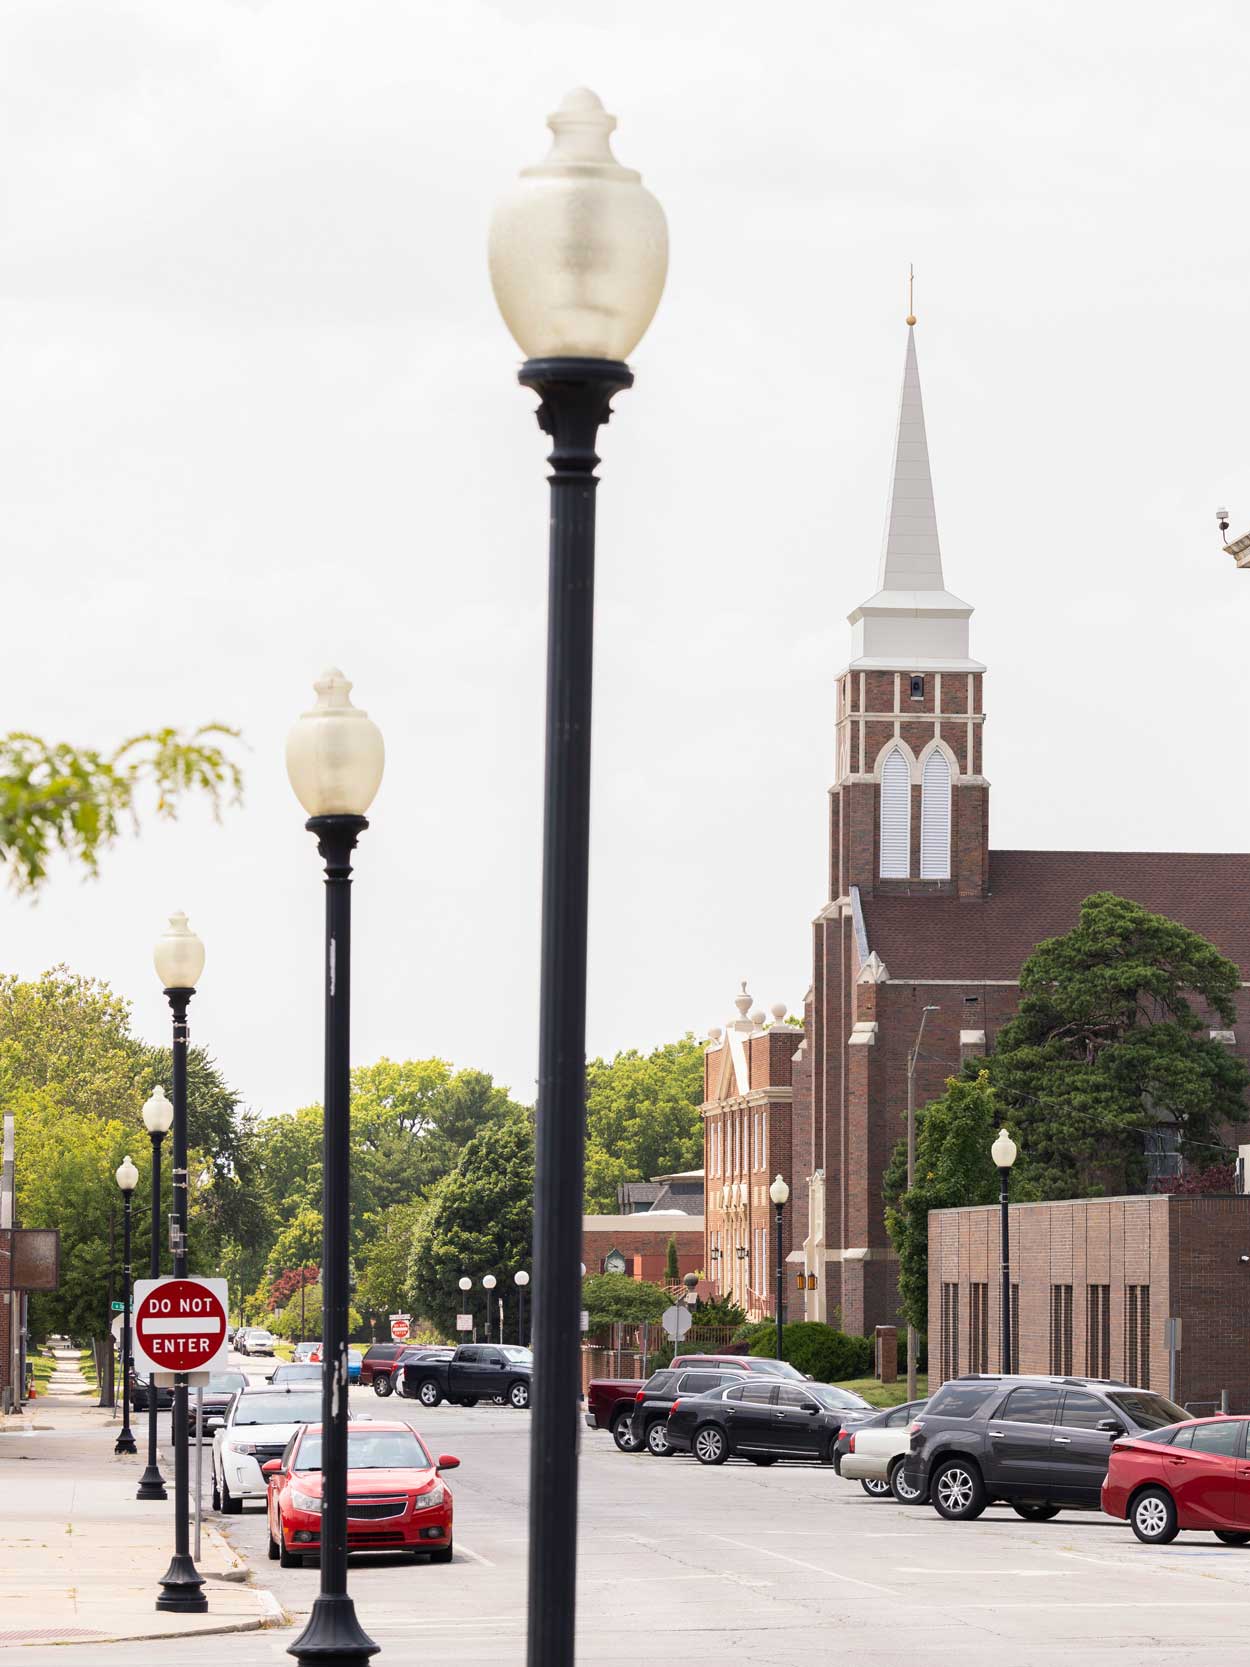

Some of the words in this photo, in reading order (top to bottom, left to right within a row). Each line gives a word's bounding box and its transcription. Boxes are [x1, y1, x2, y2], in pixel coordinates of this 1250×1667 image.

[149, 1299, 171, 1313] DO
[180, 1298, 213, 1313] NOT
[153, 1338, 210, 1353] ENTER
